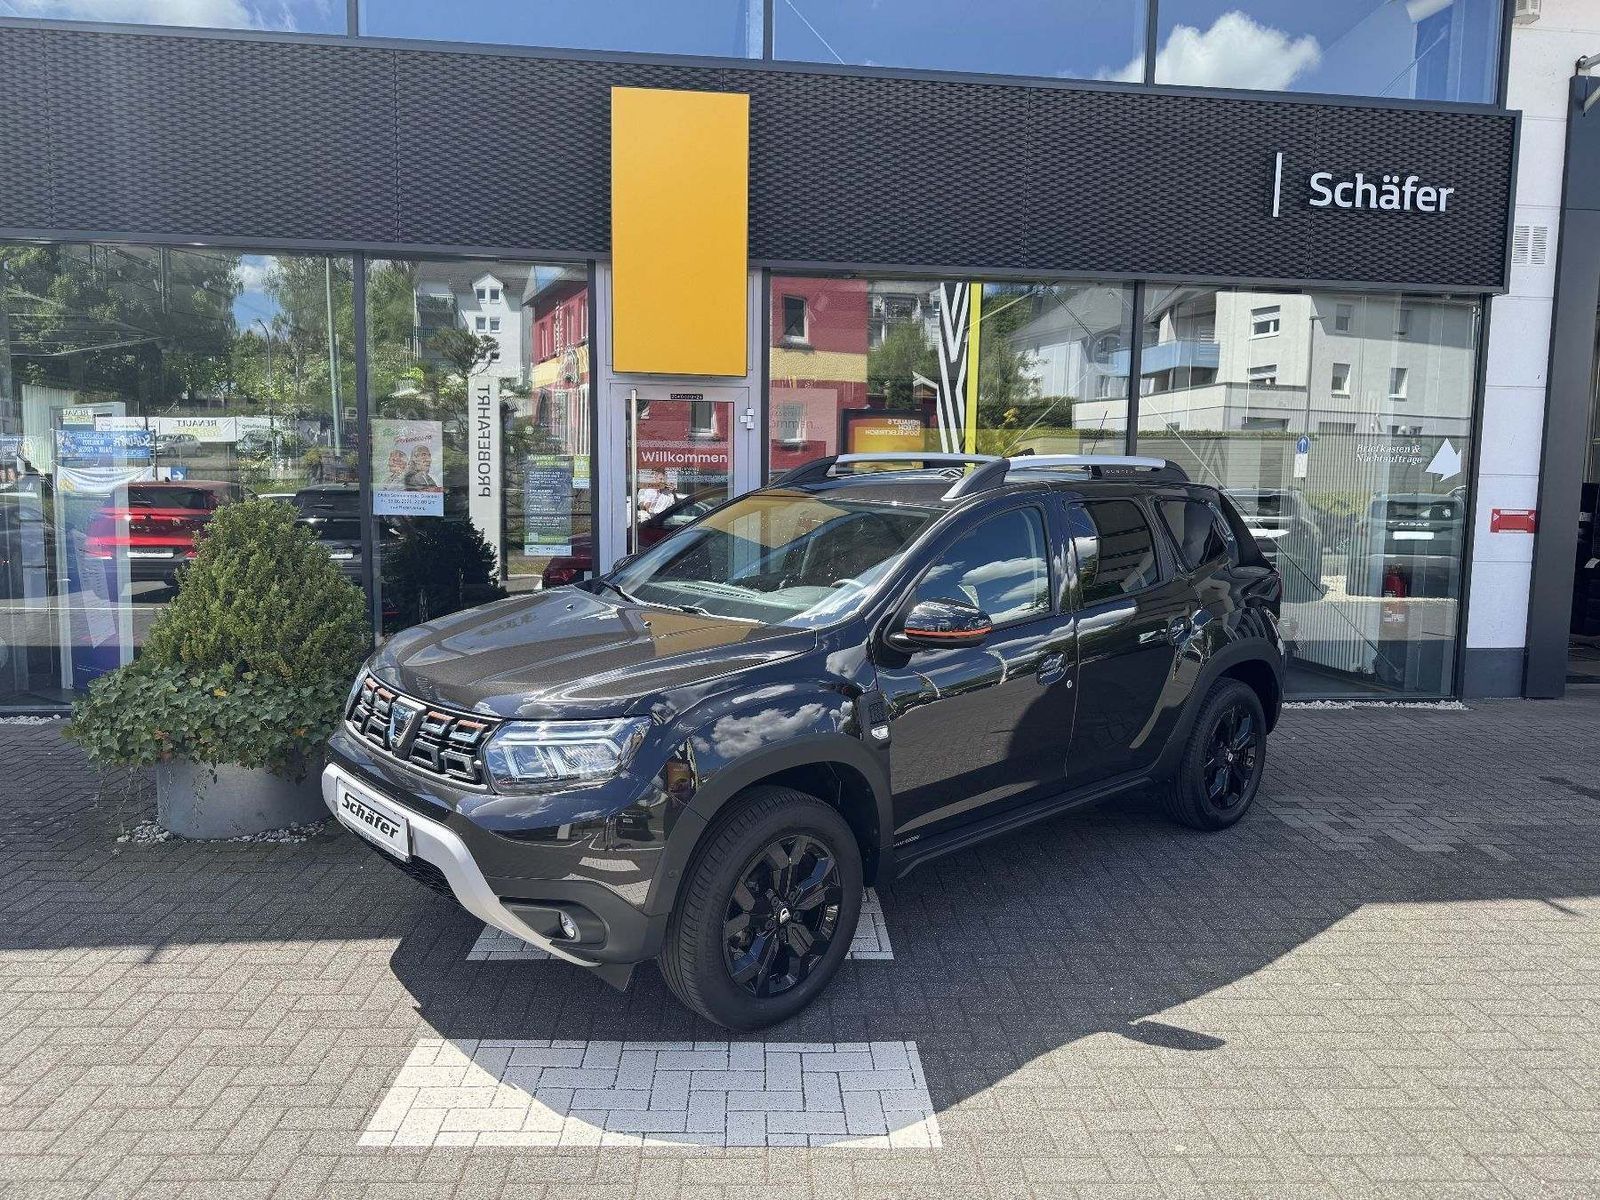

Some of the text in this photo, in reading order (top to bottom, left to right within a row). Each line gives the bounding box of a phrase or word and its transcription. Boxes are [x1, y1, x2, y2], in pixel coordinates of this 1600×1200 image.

[1309, 172, 1454, 211] Schäfer
[641, 451, 728, 463] Willkommen
[1411, 444, 1421, 453] &
[341, 792, 400, 839] Schäfer
